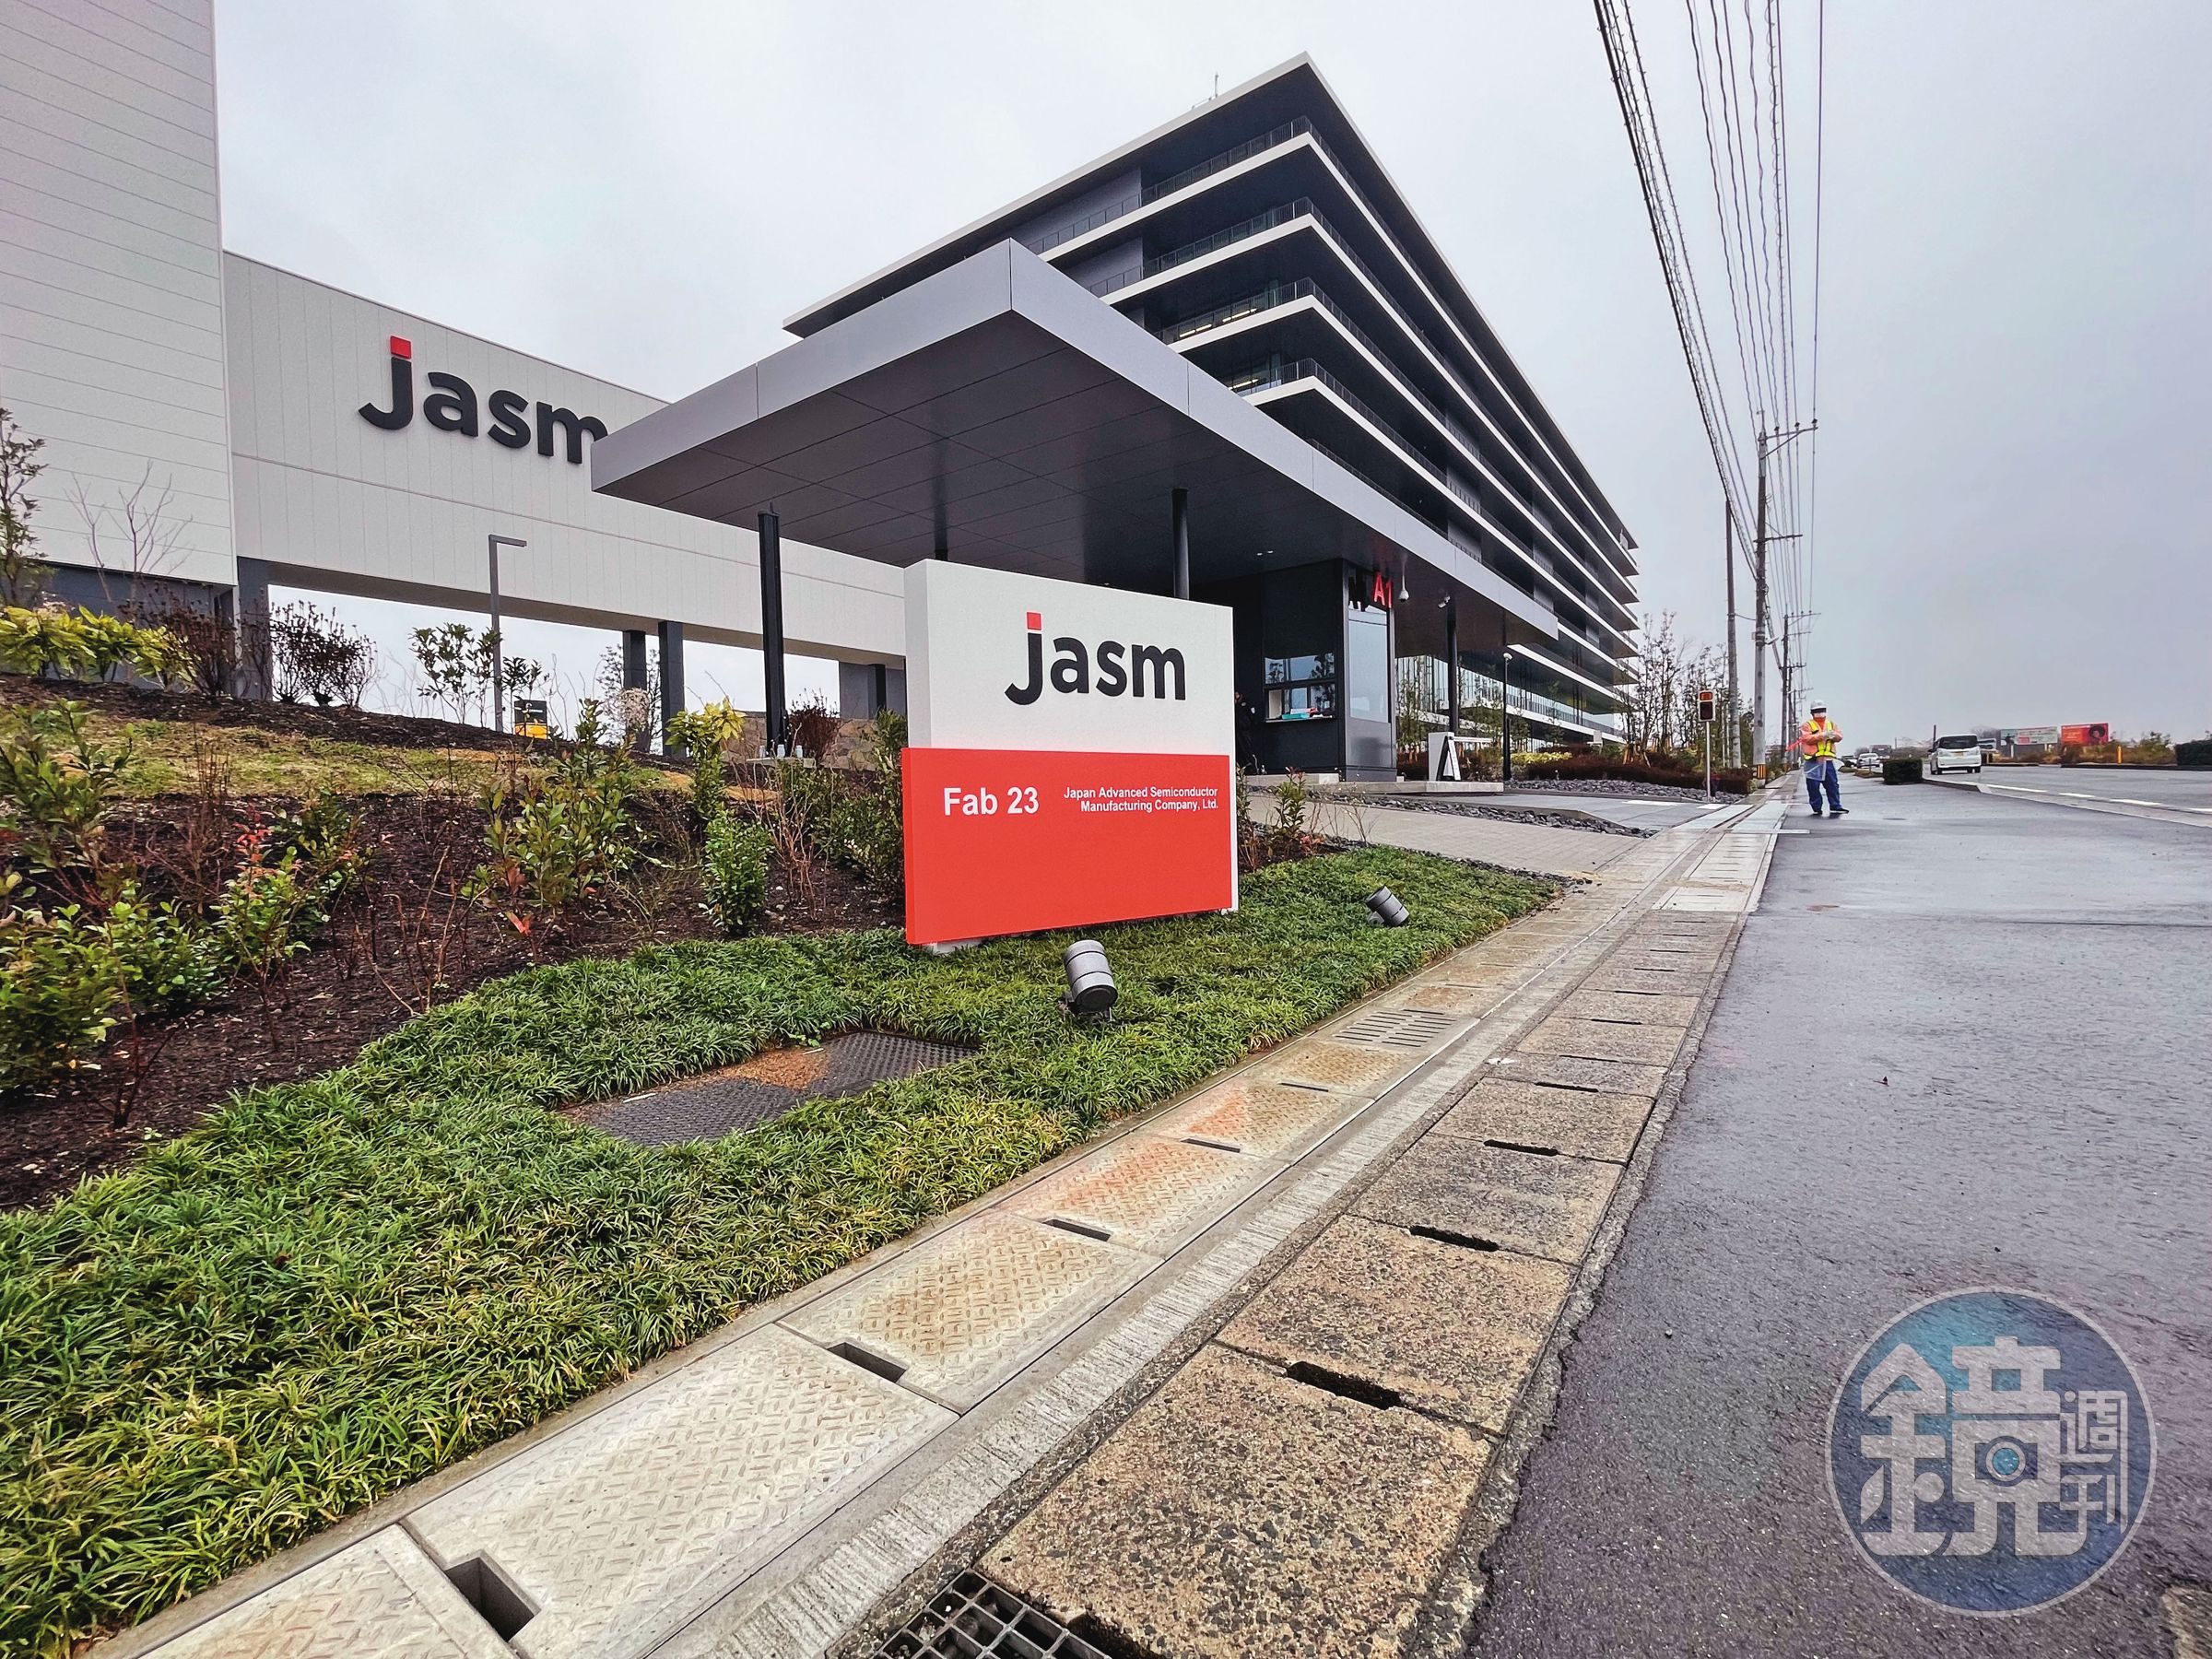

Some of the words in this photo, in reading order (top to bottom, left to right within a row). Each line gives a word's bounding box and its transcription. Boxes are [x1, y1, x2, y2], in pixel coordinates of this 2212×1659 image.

[358, 335, 608, 465] jasm
[1373, 571, 1392, 609] A1
[1005, 611, 1186, 705] jasm
[943, 787, 998, 816] Fab
[1007, 786, 1039, 814] 23
[1064, 787, 1096, 800] Japan
[1099, 786, 1147, 798] Advanced
[1150, 786, 1218, 798] Semiconductor
[1080, 799, 1152, 813] Manufacturing
[1154, 799, 1200, 811] Company,
[1202, 798, 1219, 809] Ltd.
